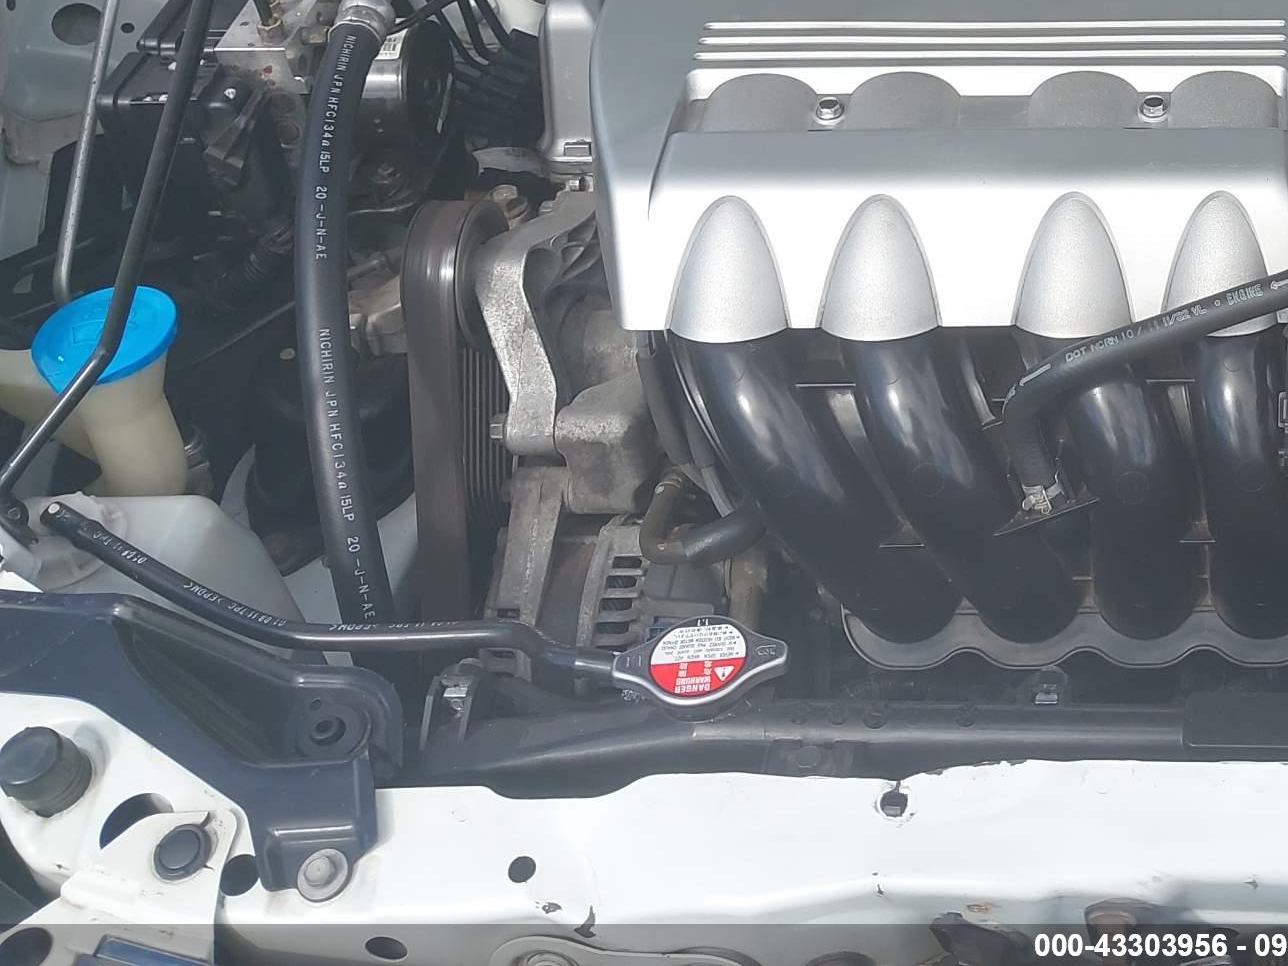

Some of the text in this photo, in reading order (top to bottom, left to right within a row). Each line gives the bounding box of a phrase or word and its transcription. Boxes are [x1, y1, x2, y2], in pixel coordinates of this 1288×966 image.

[336, 35, 357, 71] NICHIRIN
[330, 74, 344, 94] JPN
[315, 186, 328, 200] 20
[1065, 345, 1087, 362] DOT
[1227, 284, 1265, 306] ENGINE
[319, 328, 335, 384] NICHIRIN
[325, 390, 338, 417] JPN
[347, 536, 360, 553] 20
[674, 683, 711, 694] DANGER
[676, 676, 712, 685] WARNUNG
